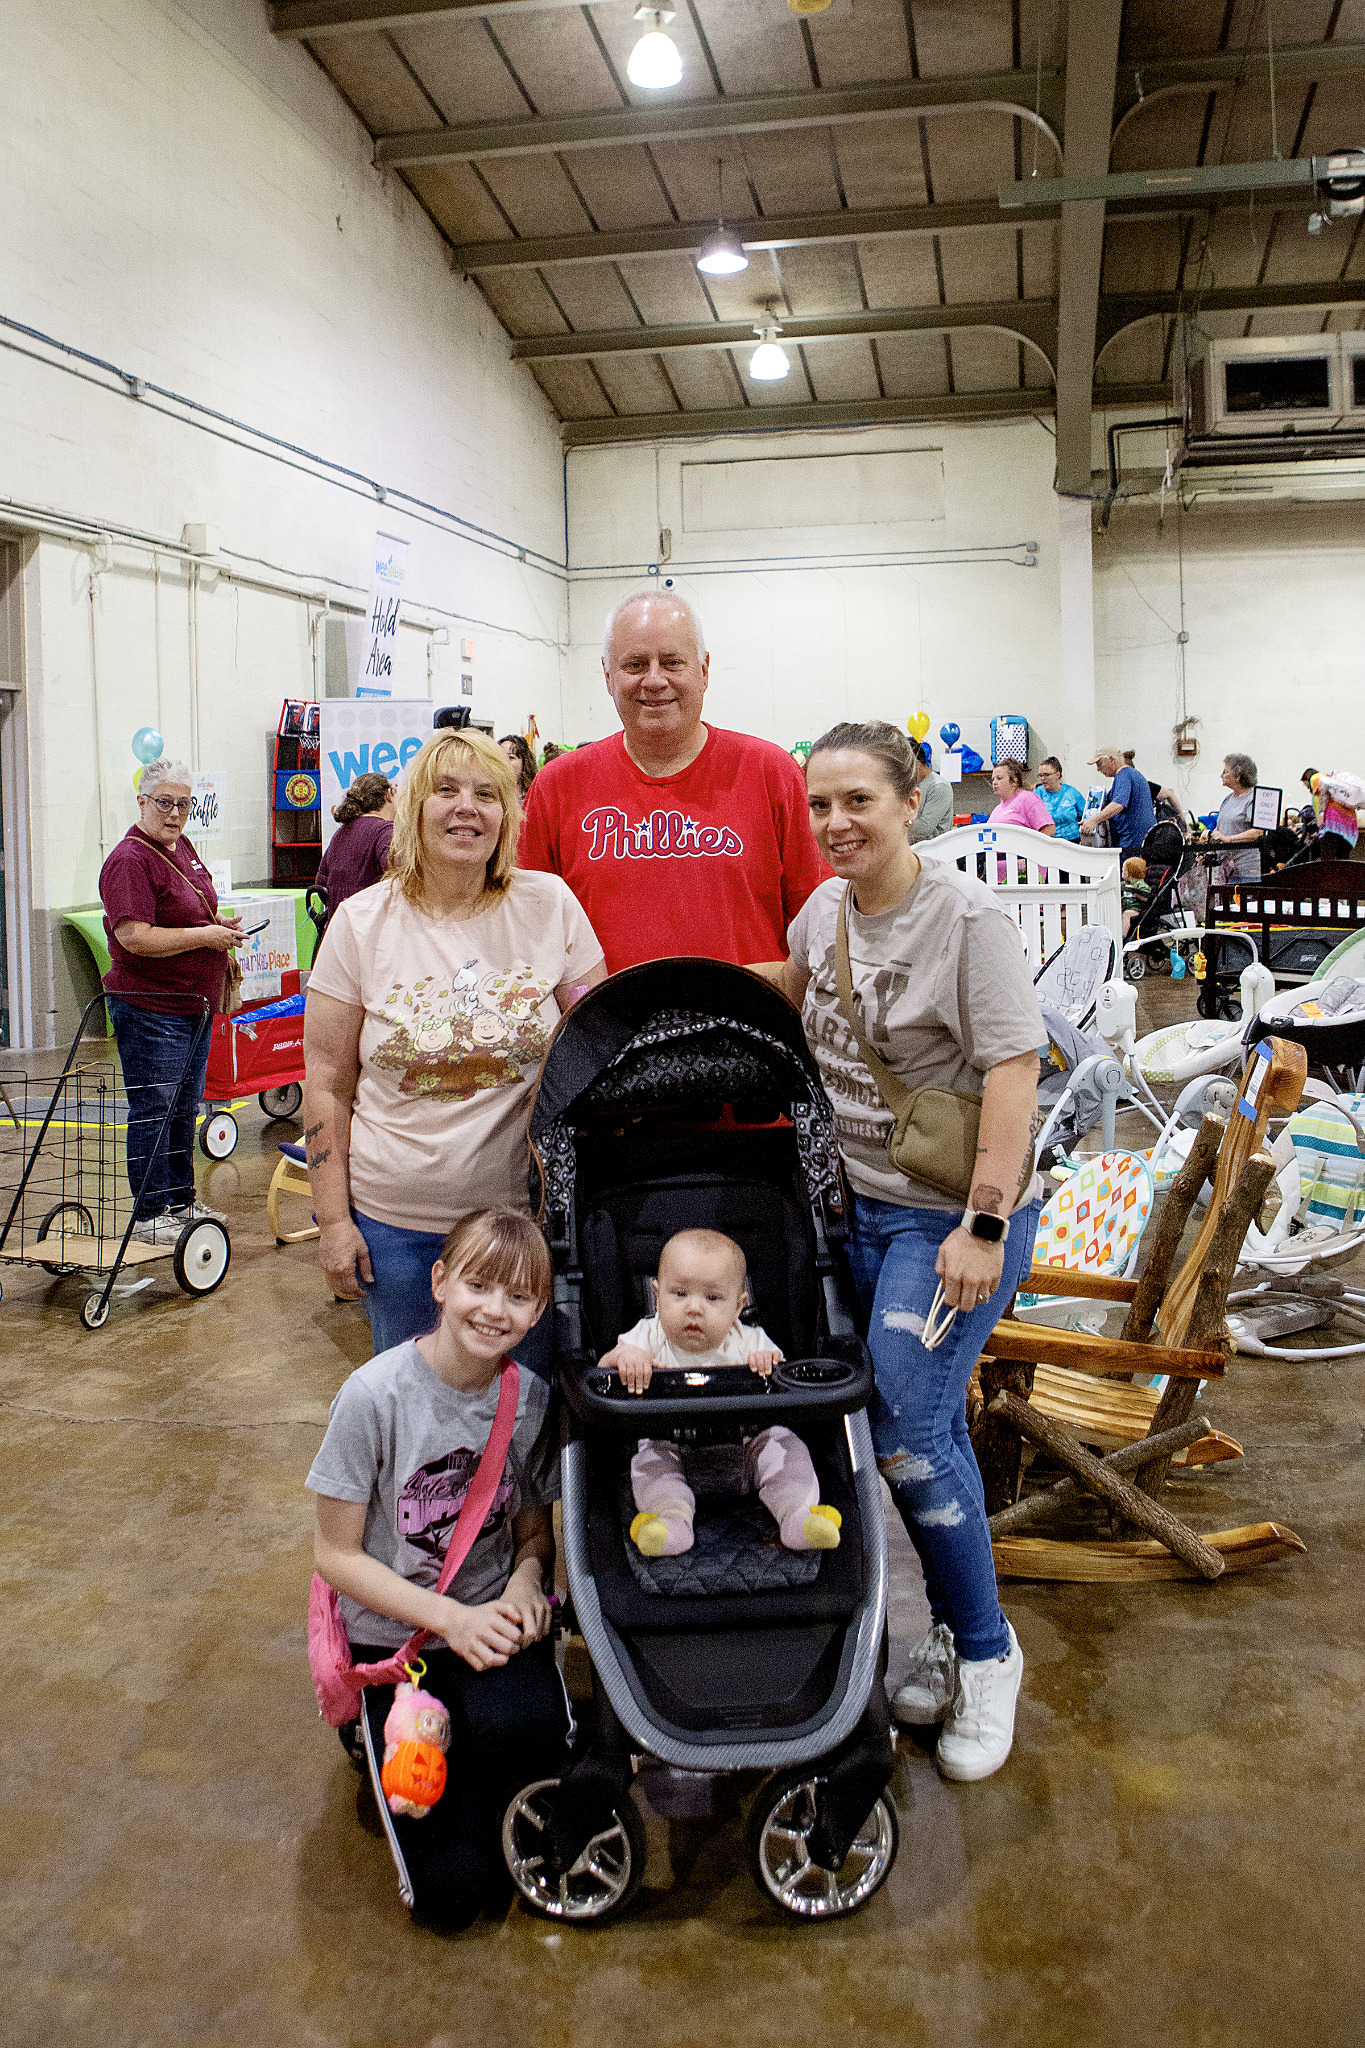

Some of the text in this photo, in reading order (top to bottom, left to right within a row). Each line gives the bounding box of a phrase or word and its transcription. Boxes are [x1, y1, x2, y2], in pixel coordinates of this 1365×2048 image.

[371, 595, 401, 638] Hold
[365, 636, 393, 677] Area
[189, 792, 218, 828] Raffle
[581, 805, 744, 861] Phillies
